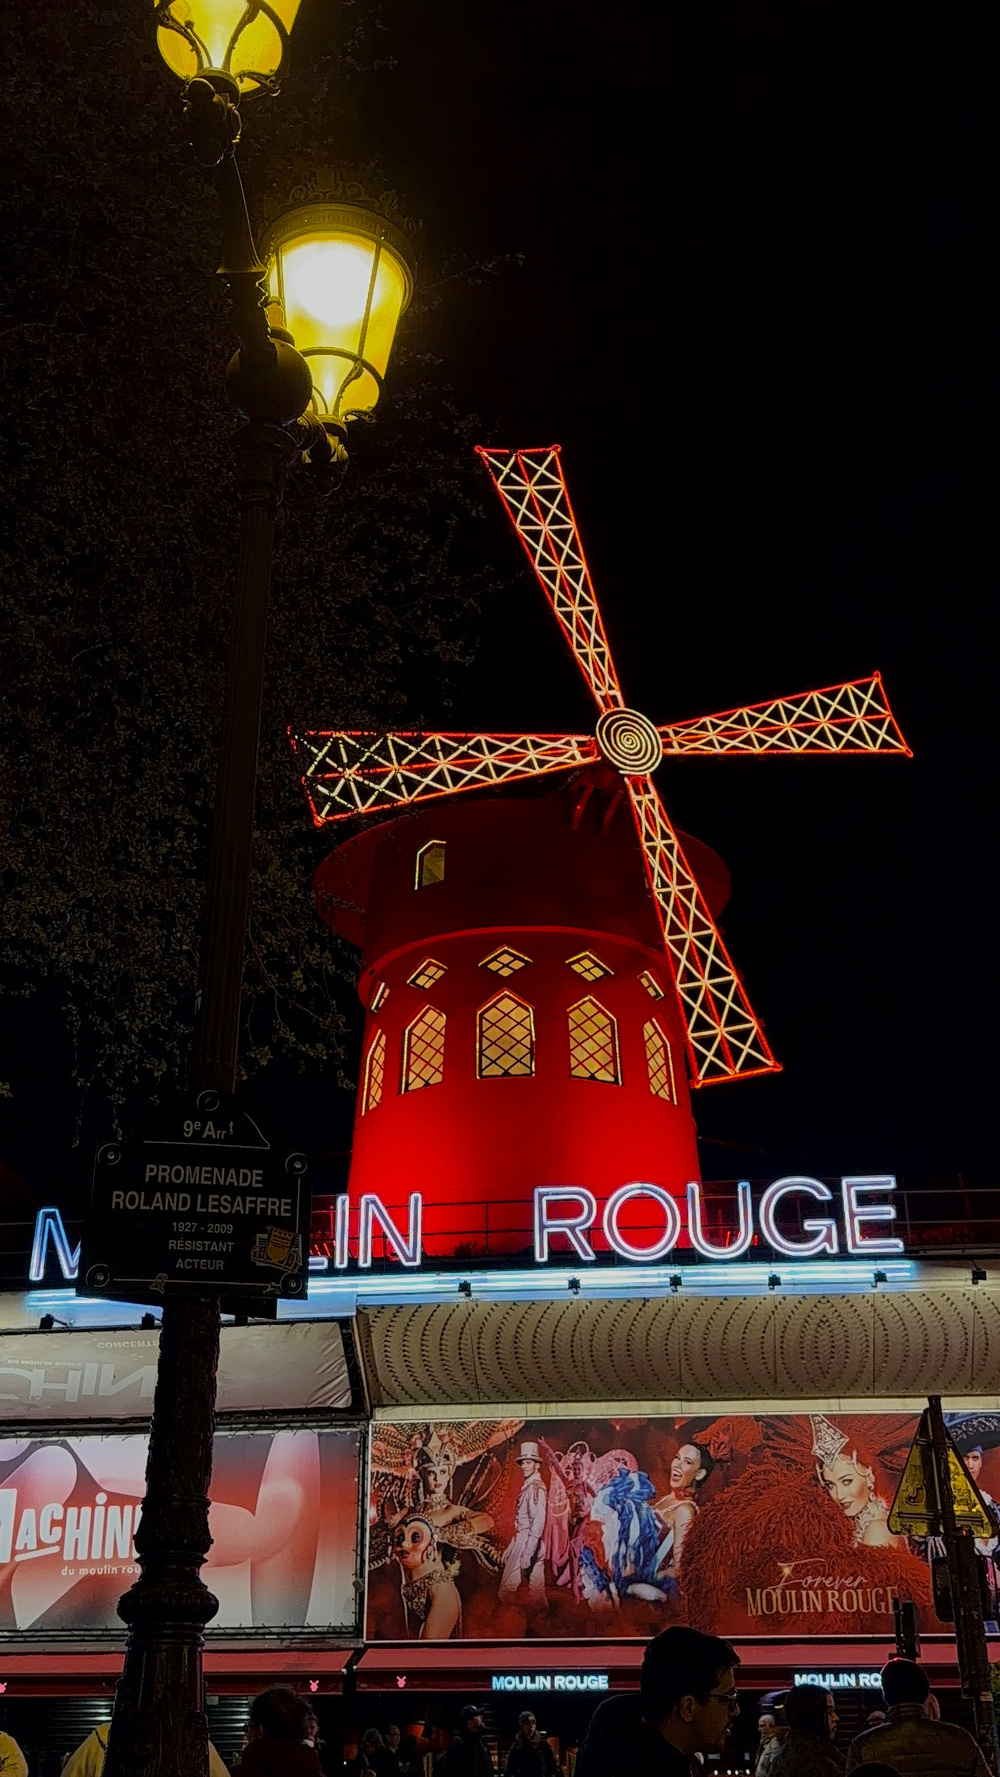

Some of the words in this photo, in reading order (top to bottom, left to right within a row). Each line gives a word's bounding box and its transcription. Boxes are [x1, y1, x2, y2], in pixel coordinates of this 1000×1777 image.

[144, 1164, 264, 1188] PROMENADE
[111, 1190, 191, 1213] ROLAND
[196, 1193, 292, 1217] LESAFFRE
[533, 1174, 905, 1263] ROUGE
[171, 1222, 198, 1233] 1927
[207, 1223, 234, 1234] 2009
[168, 1237, 235, 1253] RÉSISTANT
[175, 1258, 225, 1271] ACTEUR
[61, 1565, 75, 1576] du
[78, 1564, 118, 1576] moulin
[767, 1557, 869, 1597] Forever
[745, 1587, 823, 1617] MOULIN
[827, 1586, 899, 1615] ROUGE
[491, 1675, 551, 1690] MOULIN
[554, 1675, 609, 1690] ROUGE
[794, 1673, 856, 1688] MOULIN
